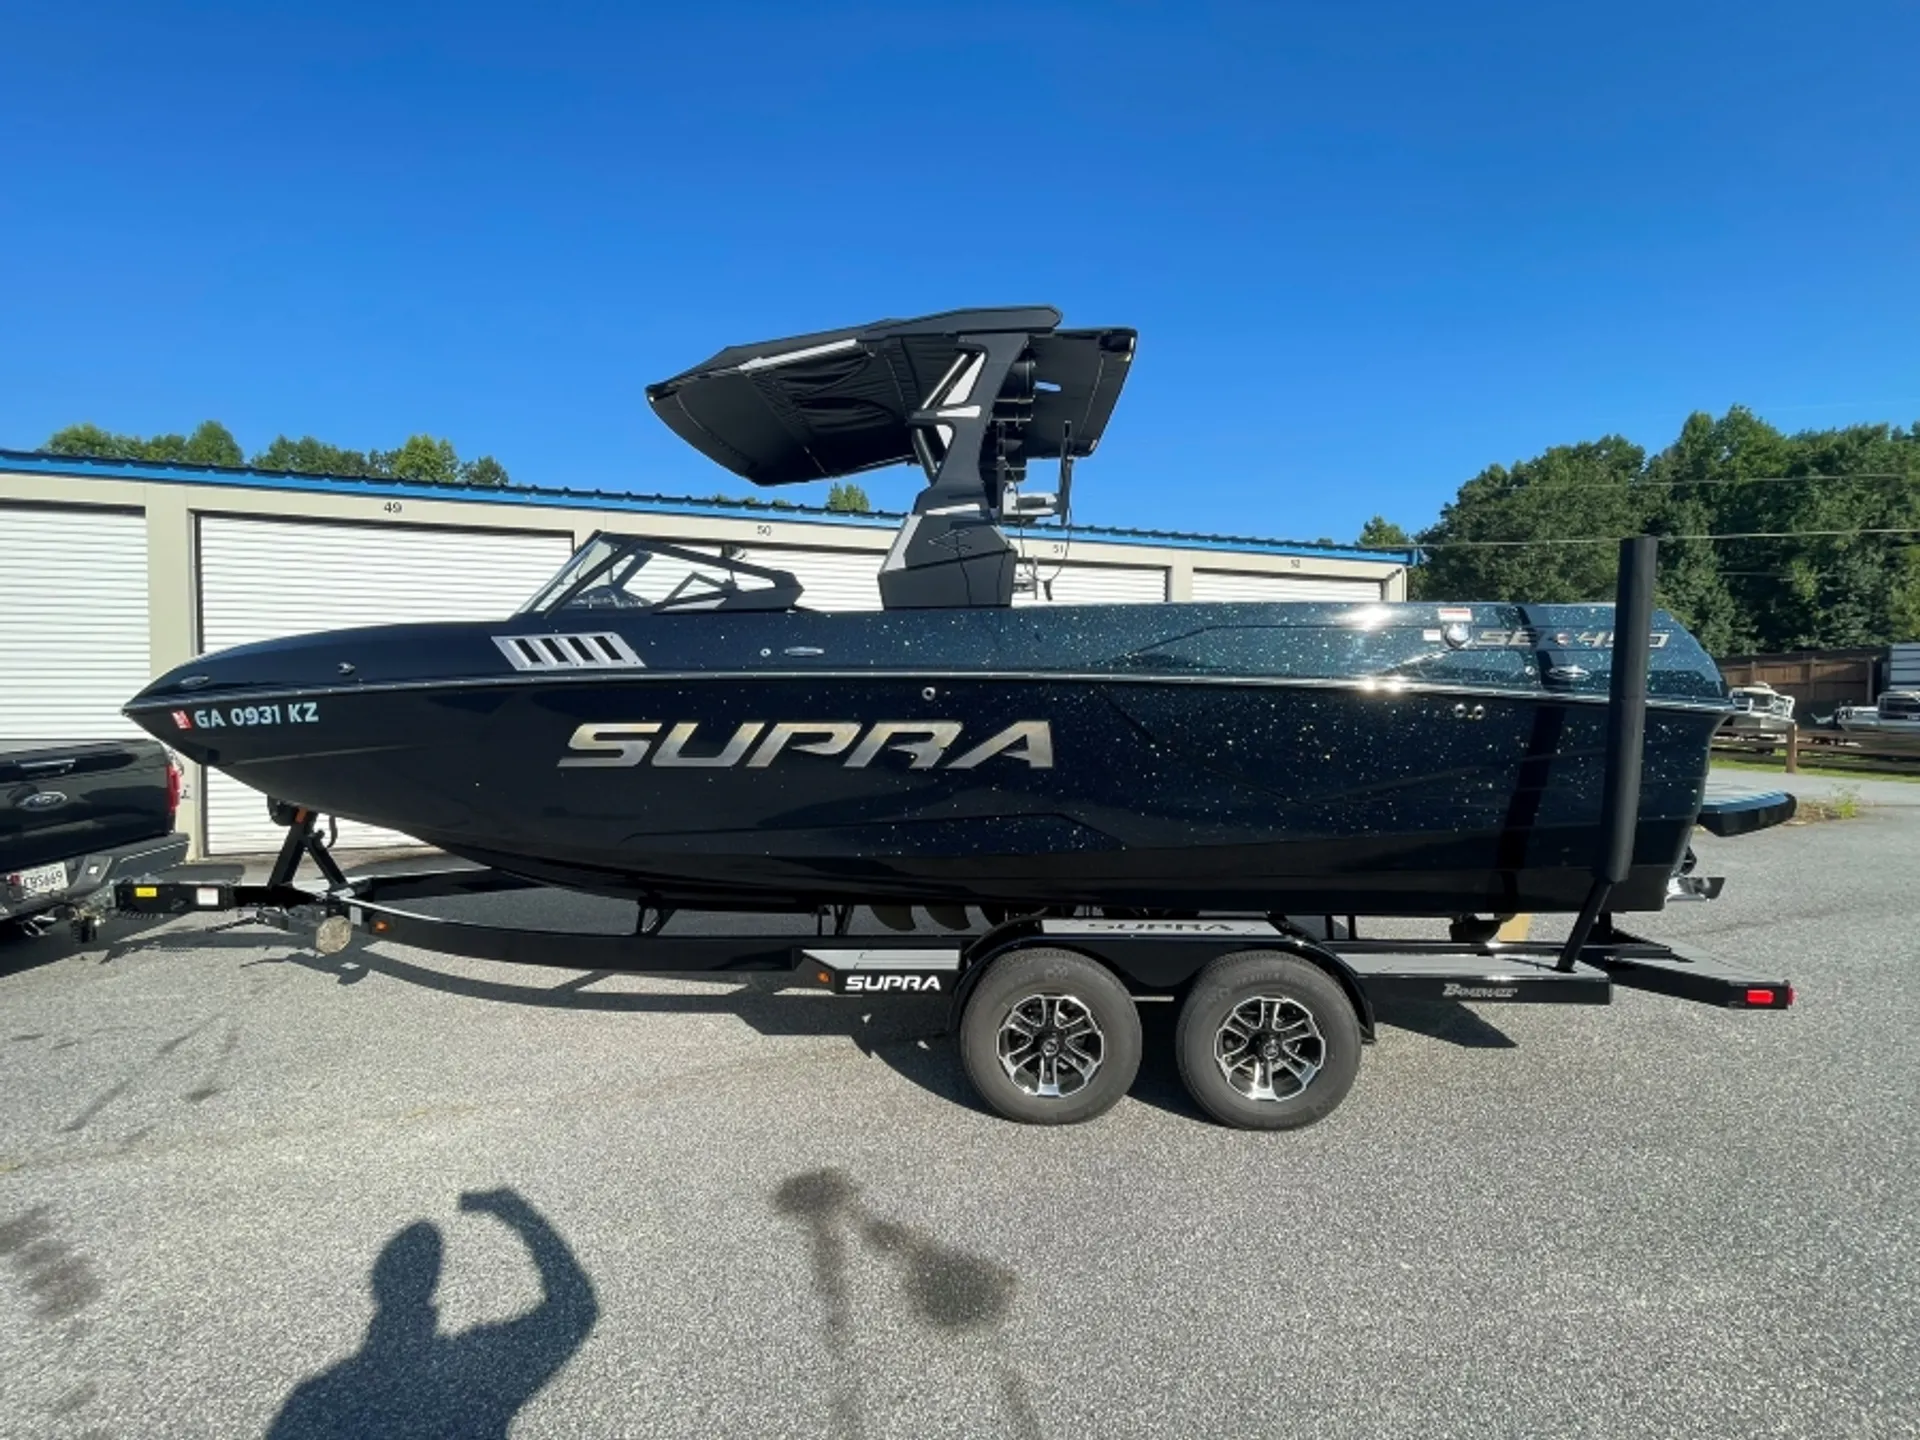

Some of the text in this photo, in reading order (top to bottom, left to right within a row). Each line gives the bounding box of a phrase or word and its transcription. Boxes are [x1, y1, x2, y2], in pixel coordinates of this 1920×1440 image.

[383, 501, 402, 513] 49
[757, 524, 771, 536] 50
[1052, 544, 1064, 554] 51
[193, 708, 227, 729] GA
[230, 704, 282, 726] 0931
[287, 702, 319, 723] KZ
[557, 720, 1054, 769] SUPRA
[845, 975, 941, 991] SUPRA
